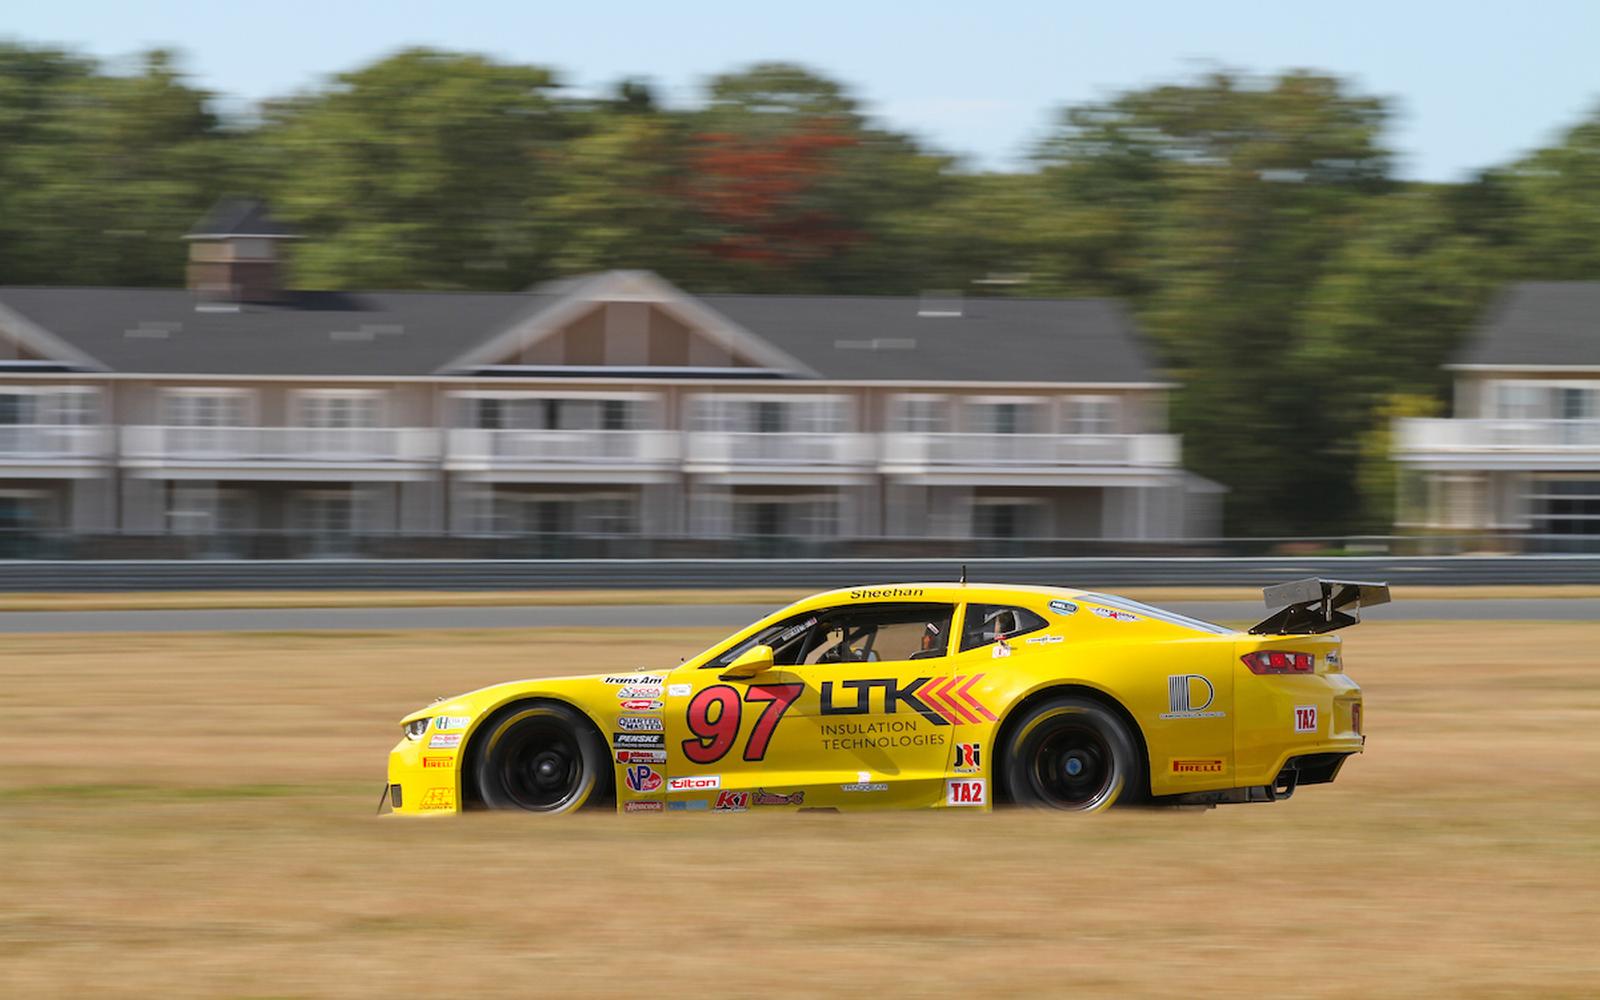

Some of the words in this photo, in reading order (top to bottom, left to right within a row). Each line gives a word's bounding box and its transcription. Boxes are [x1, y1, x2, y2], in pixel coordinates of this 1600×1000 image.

[850, 588, 924, 600] Sheehan
[639, 676, 663, 684] Am
[821, 678, 950, 725] LTK
[682, 684, 804, 763] 97
[1296, 709, 1316, 729] TA2
[821, 721, 917, 735] INSULATION
[618, 734, 660, 743] PENSKE
[822, 734, 945, 750] TECHNOLOGIES
[423, 757, 453, 768] PIRELLI
[1173, 760, 1222, 772] PIRELLI
[627, 765, 651, 791] VP
[670, 779, 716, 788] tilton
[716, 792, 748, 807] K1
[950, 783, 982, 802] TA2
